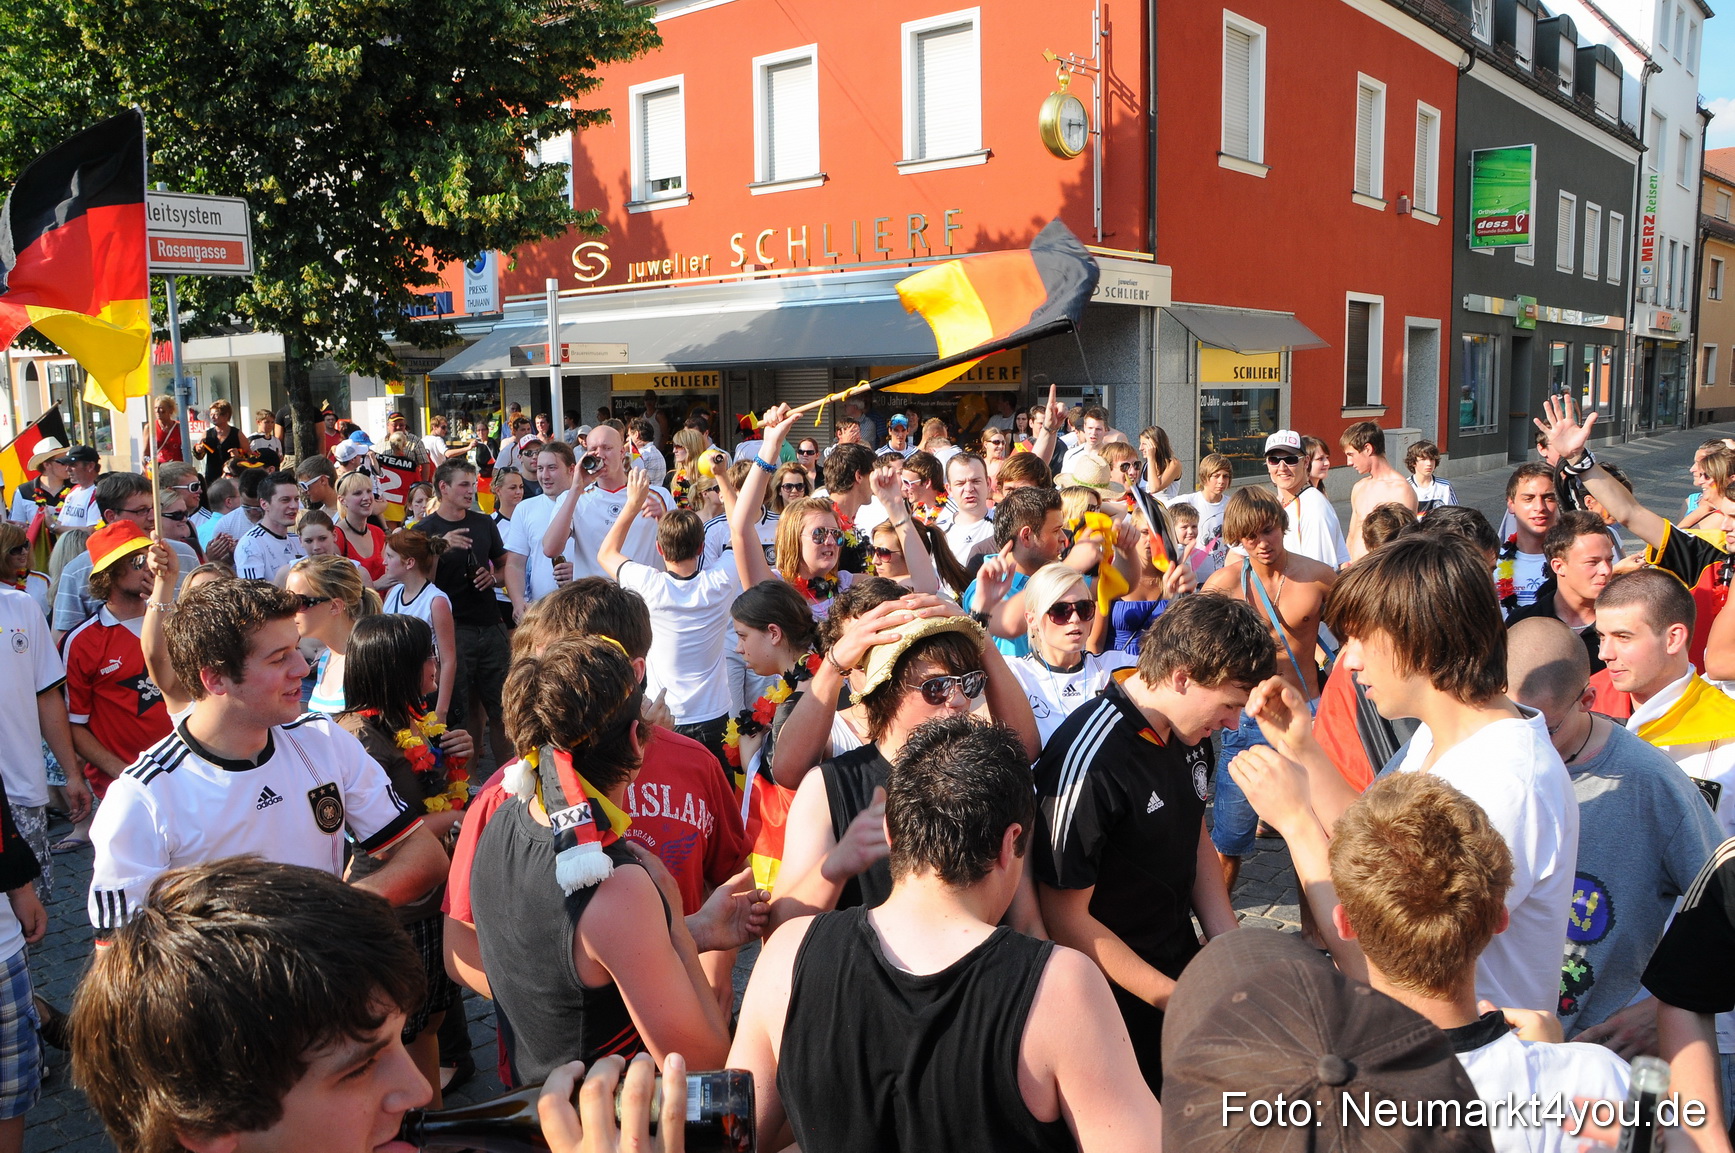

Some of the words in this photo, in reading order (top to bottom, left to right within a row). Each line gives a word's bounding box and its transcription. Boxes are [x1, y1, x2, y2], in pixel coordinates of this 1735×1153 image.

[1646, 174, 1658, 214] Reisen
[1477, 220, 1509, 229] dess
[730, 208, 963, 268] SCHLIERF
[1641, 214, 1656, 262] MERZ
[157, 239, 227, 263] Rosengasse
[468, 284, 489, 295] PRESSE
[1105, 286, 1150, 301] SCHLIERF
[467, 297, 491, 308] THUMANN
[1233, 366, 1280, 379] SCHLIERF
[653, 374, 719, 388] SCHLIERF
[615, 399, 622, 409] 20
[887, 395, 908, 406] Jahre
[1207, 395, 1220, 407] Jahre
[377, 466, 404, 504] 2
[256, 795, 284, 811] adidas
[1146, 800, 1165, 814] adidas
[551, 804, 592, 832] XXX
[632, 829, 656, 847] BRAND
